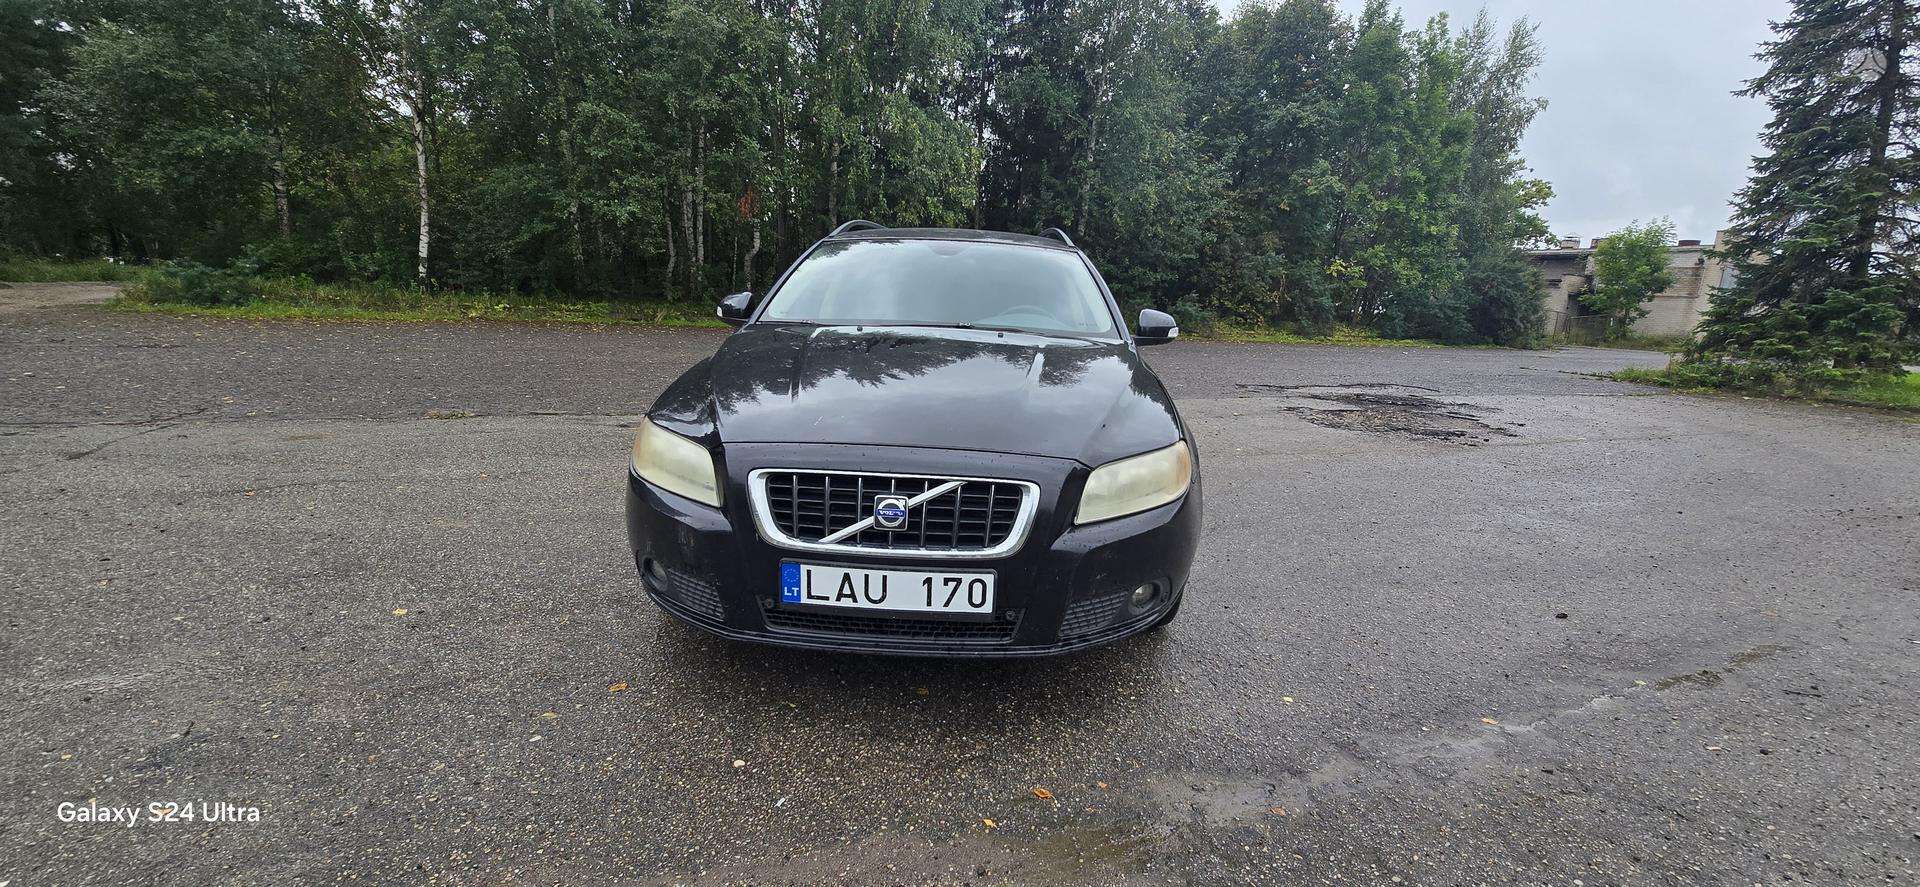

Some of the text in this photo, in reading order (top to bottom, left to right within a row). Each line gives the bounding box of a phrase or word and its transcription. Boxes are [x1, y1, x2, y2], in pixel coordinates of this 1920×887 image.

[783, 586, 799, 597] LT
[806, 569, 987, 608] LAU 170
